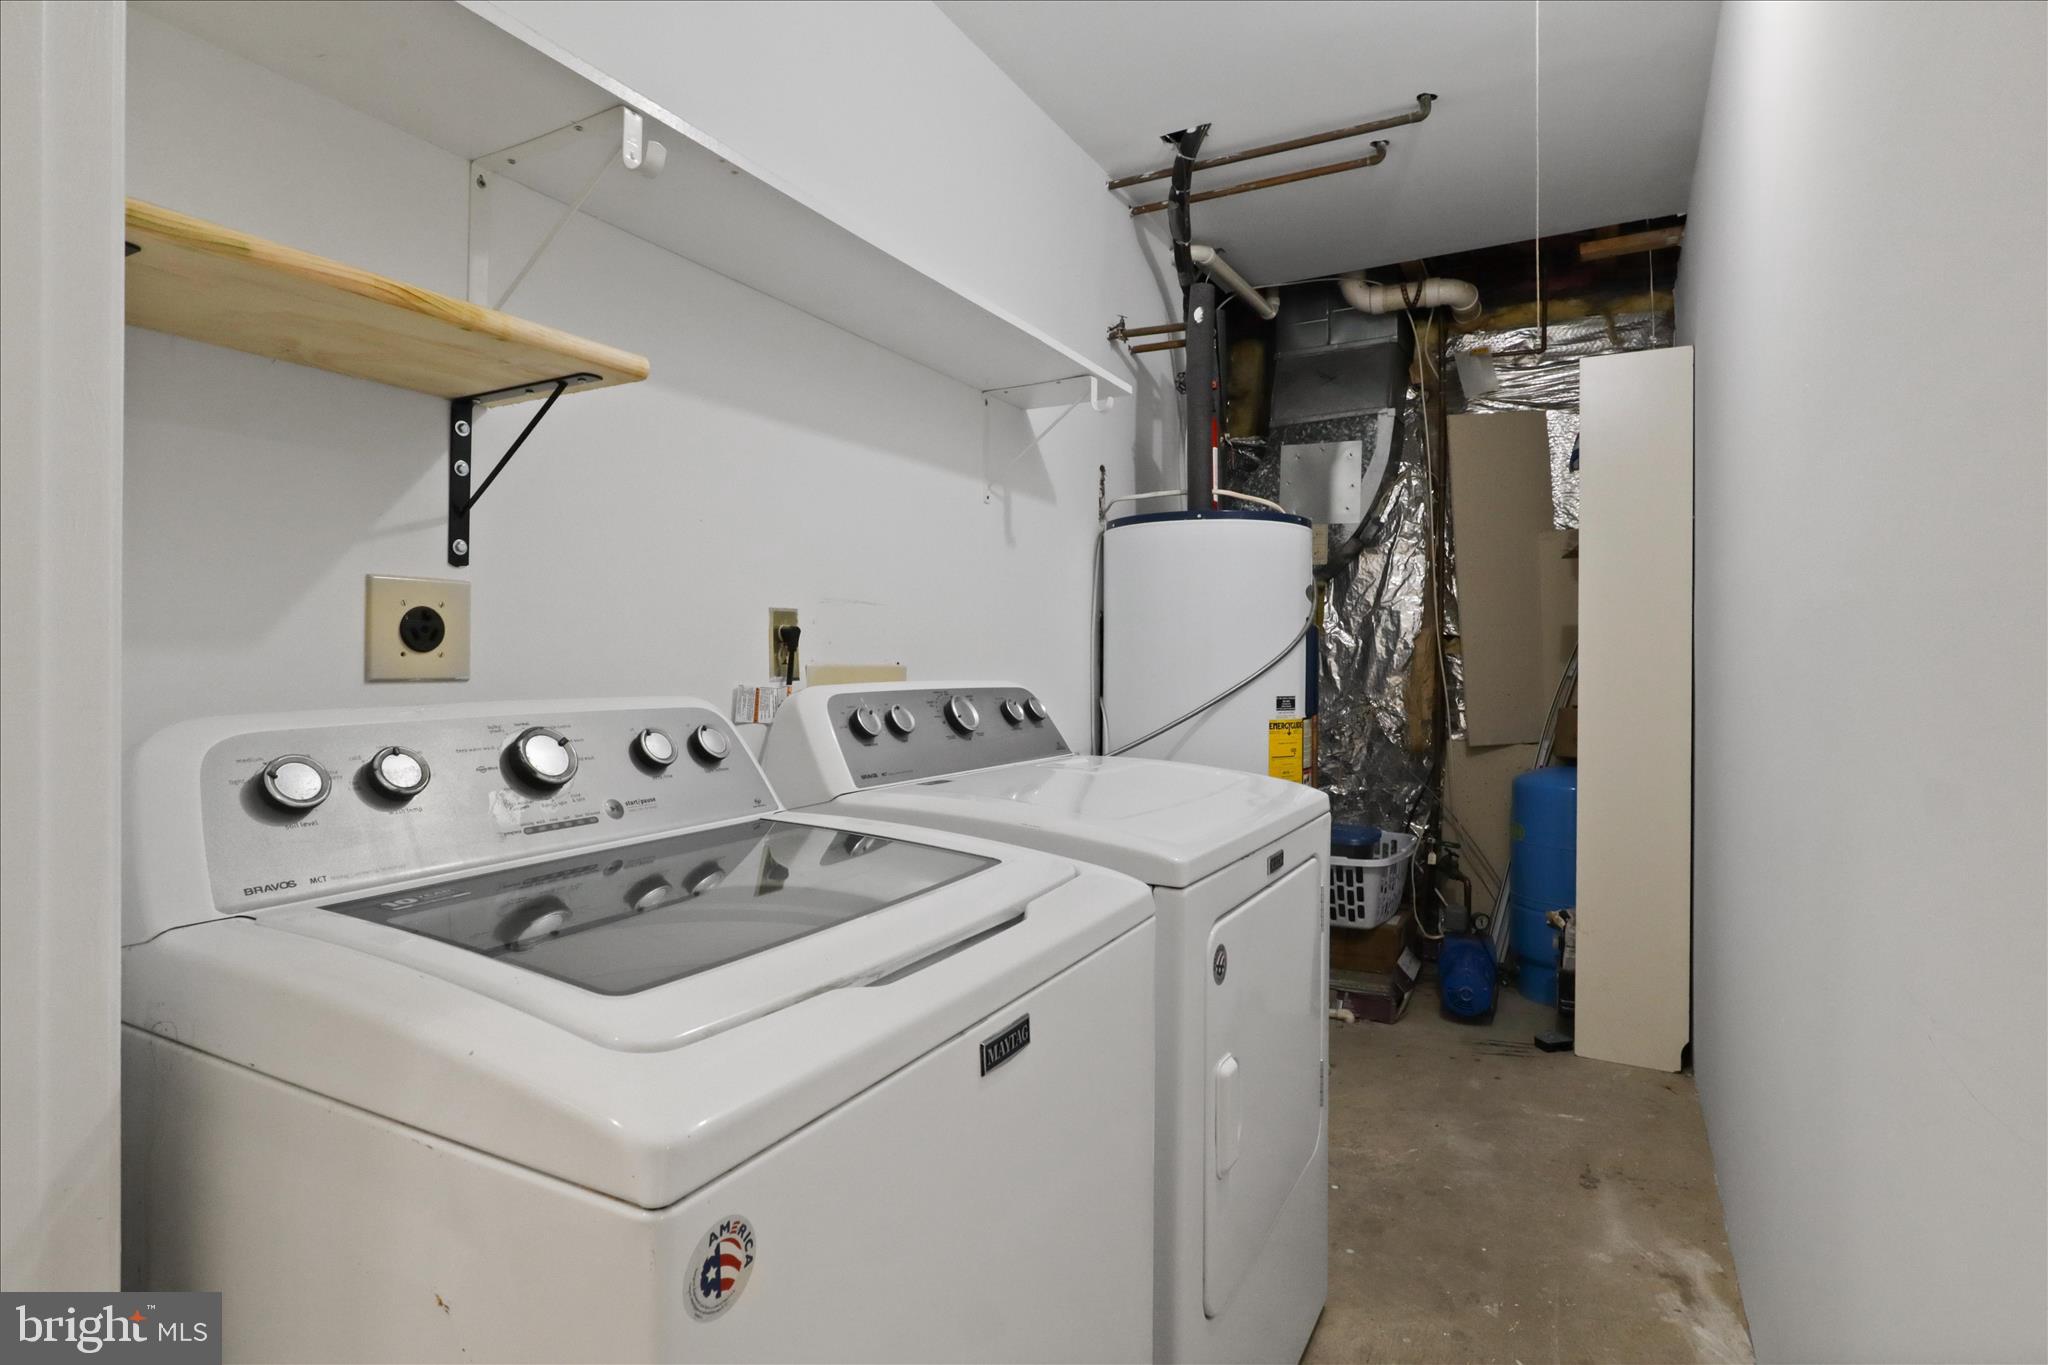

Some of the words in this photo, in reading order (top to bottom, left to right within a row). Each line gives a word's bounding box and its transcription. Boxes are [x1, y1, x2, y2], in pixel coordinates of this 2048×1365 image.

[243, 879, 298, 896] BRAVOS
[309, 874, 328, 885] MCT
[987, 1023, 1030, 1066] MAYTAG
[708, 1219, 754, 1269] AMERICA
